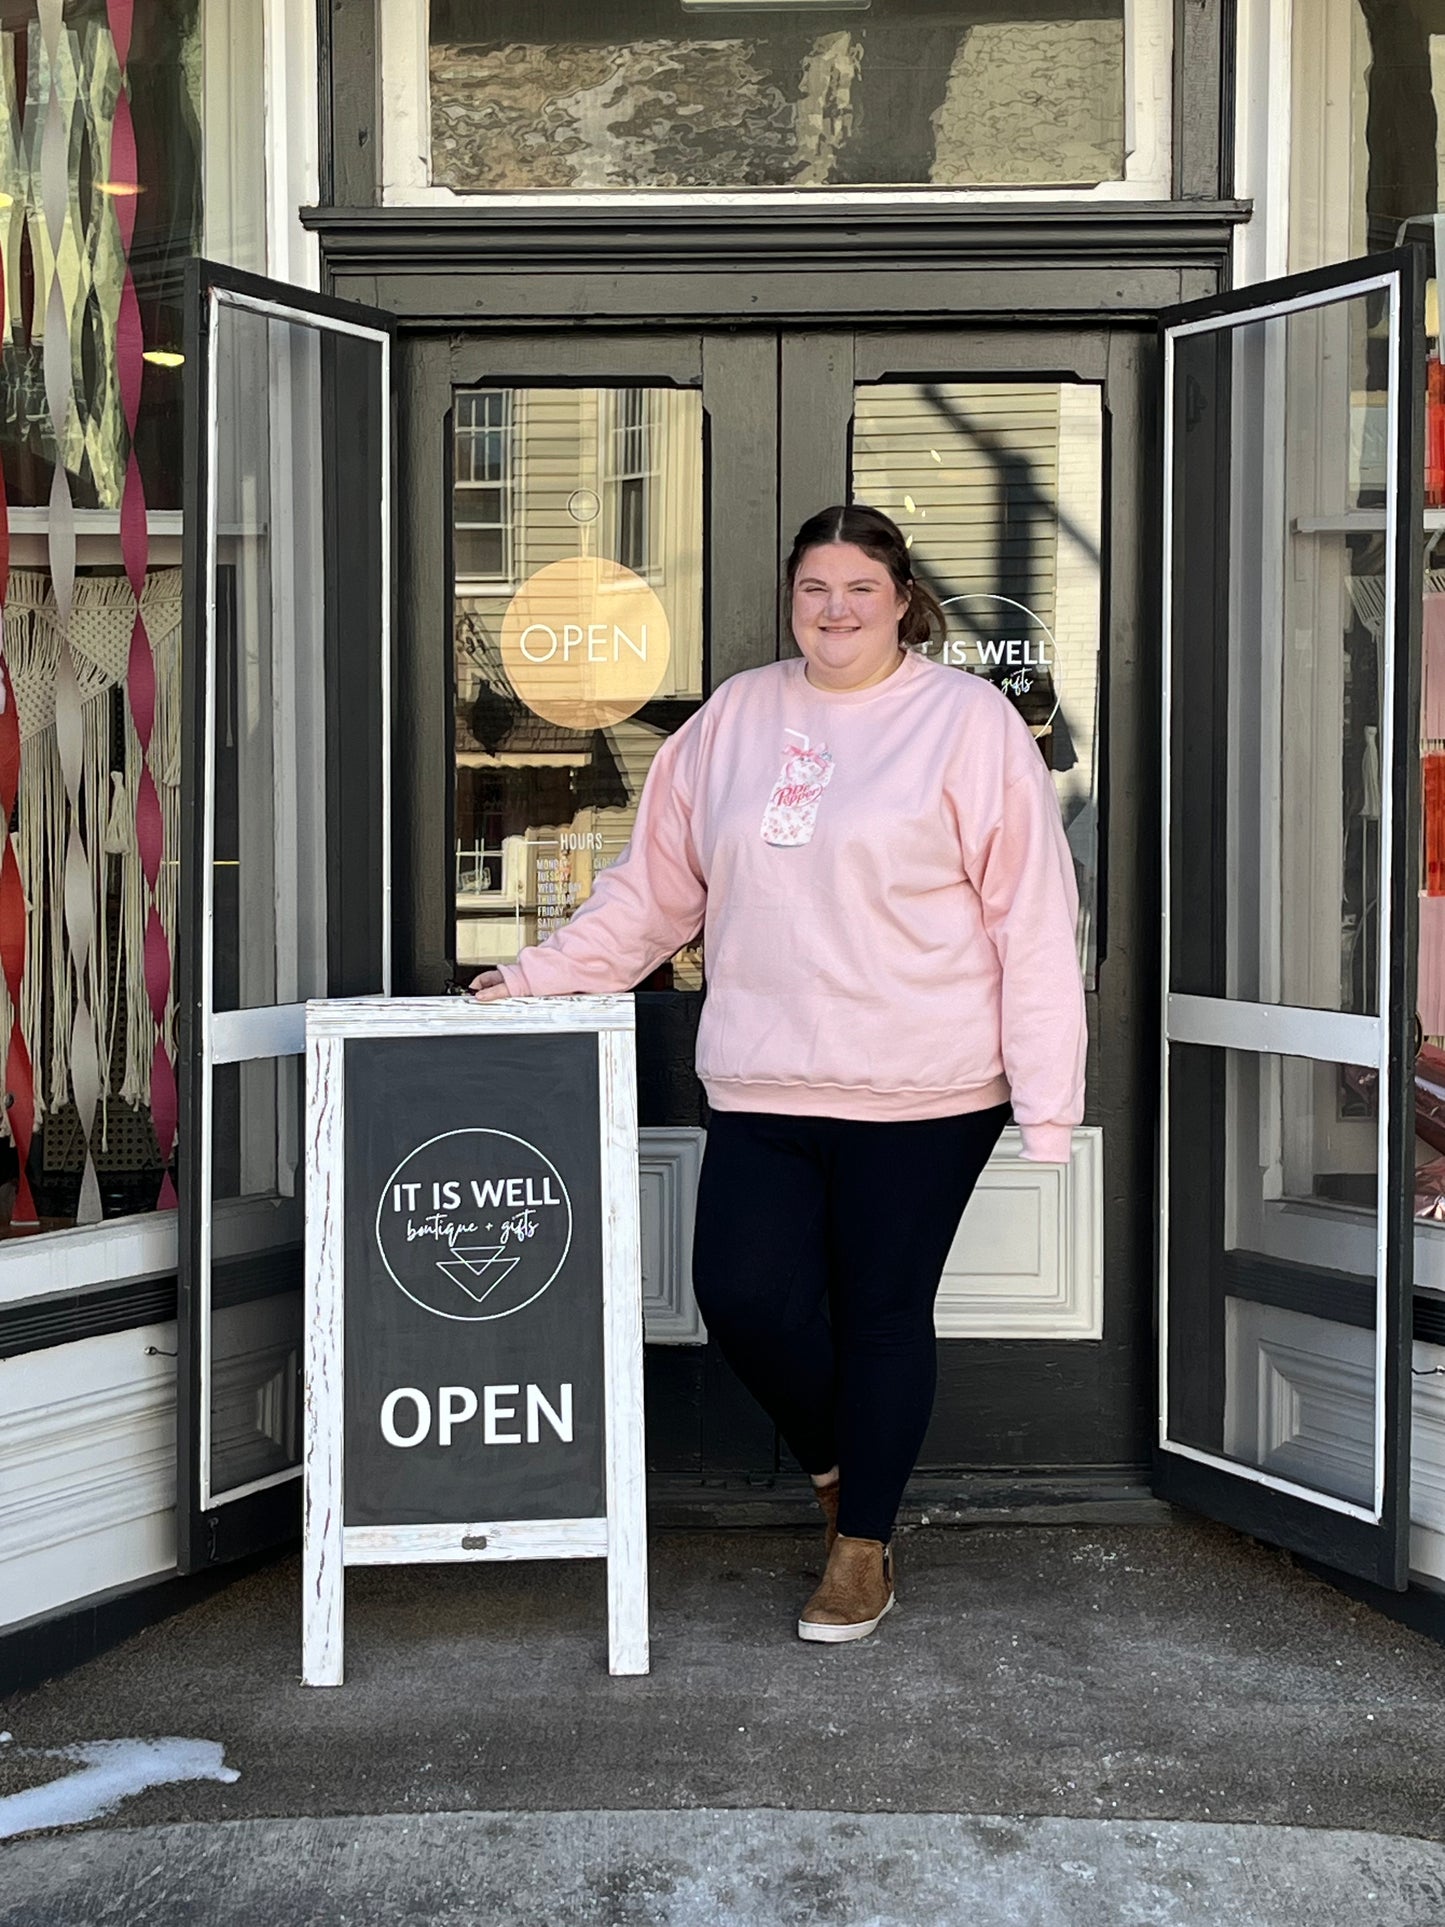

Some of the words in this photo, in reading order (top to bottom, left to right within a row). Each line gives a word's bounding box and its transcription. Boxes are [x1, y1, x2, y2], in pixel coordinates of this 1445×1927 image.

[519, 623, 648, 663] OPEN
[943, 640, 967, 665] IS
[976, 640, 1053, 665] WELL
[1001, 667, 1034, 697] gifts
[560, 833, 603, 850] HOURS
[536, 859, 568, 870] MONDAY
[537, 871, 570, 882] TUESDAY
[537, 882, 582, 893] WEDNESDAY
[537, 894, 575, 905] THURSDAY
[537, 906, 564, 917] FRIDAY
[537, 918, 571, 929] SATURDA
[393, 1182, 421, 1213] IT
[432, 1181, 461, 1210] IS
[471, 1177, 560, 1208] WELL
[406, 1213, 478, 1248] boutique
[501, 1208, 539, 1246] gifts
[380, 1383, 574, 1449] OPEN
